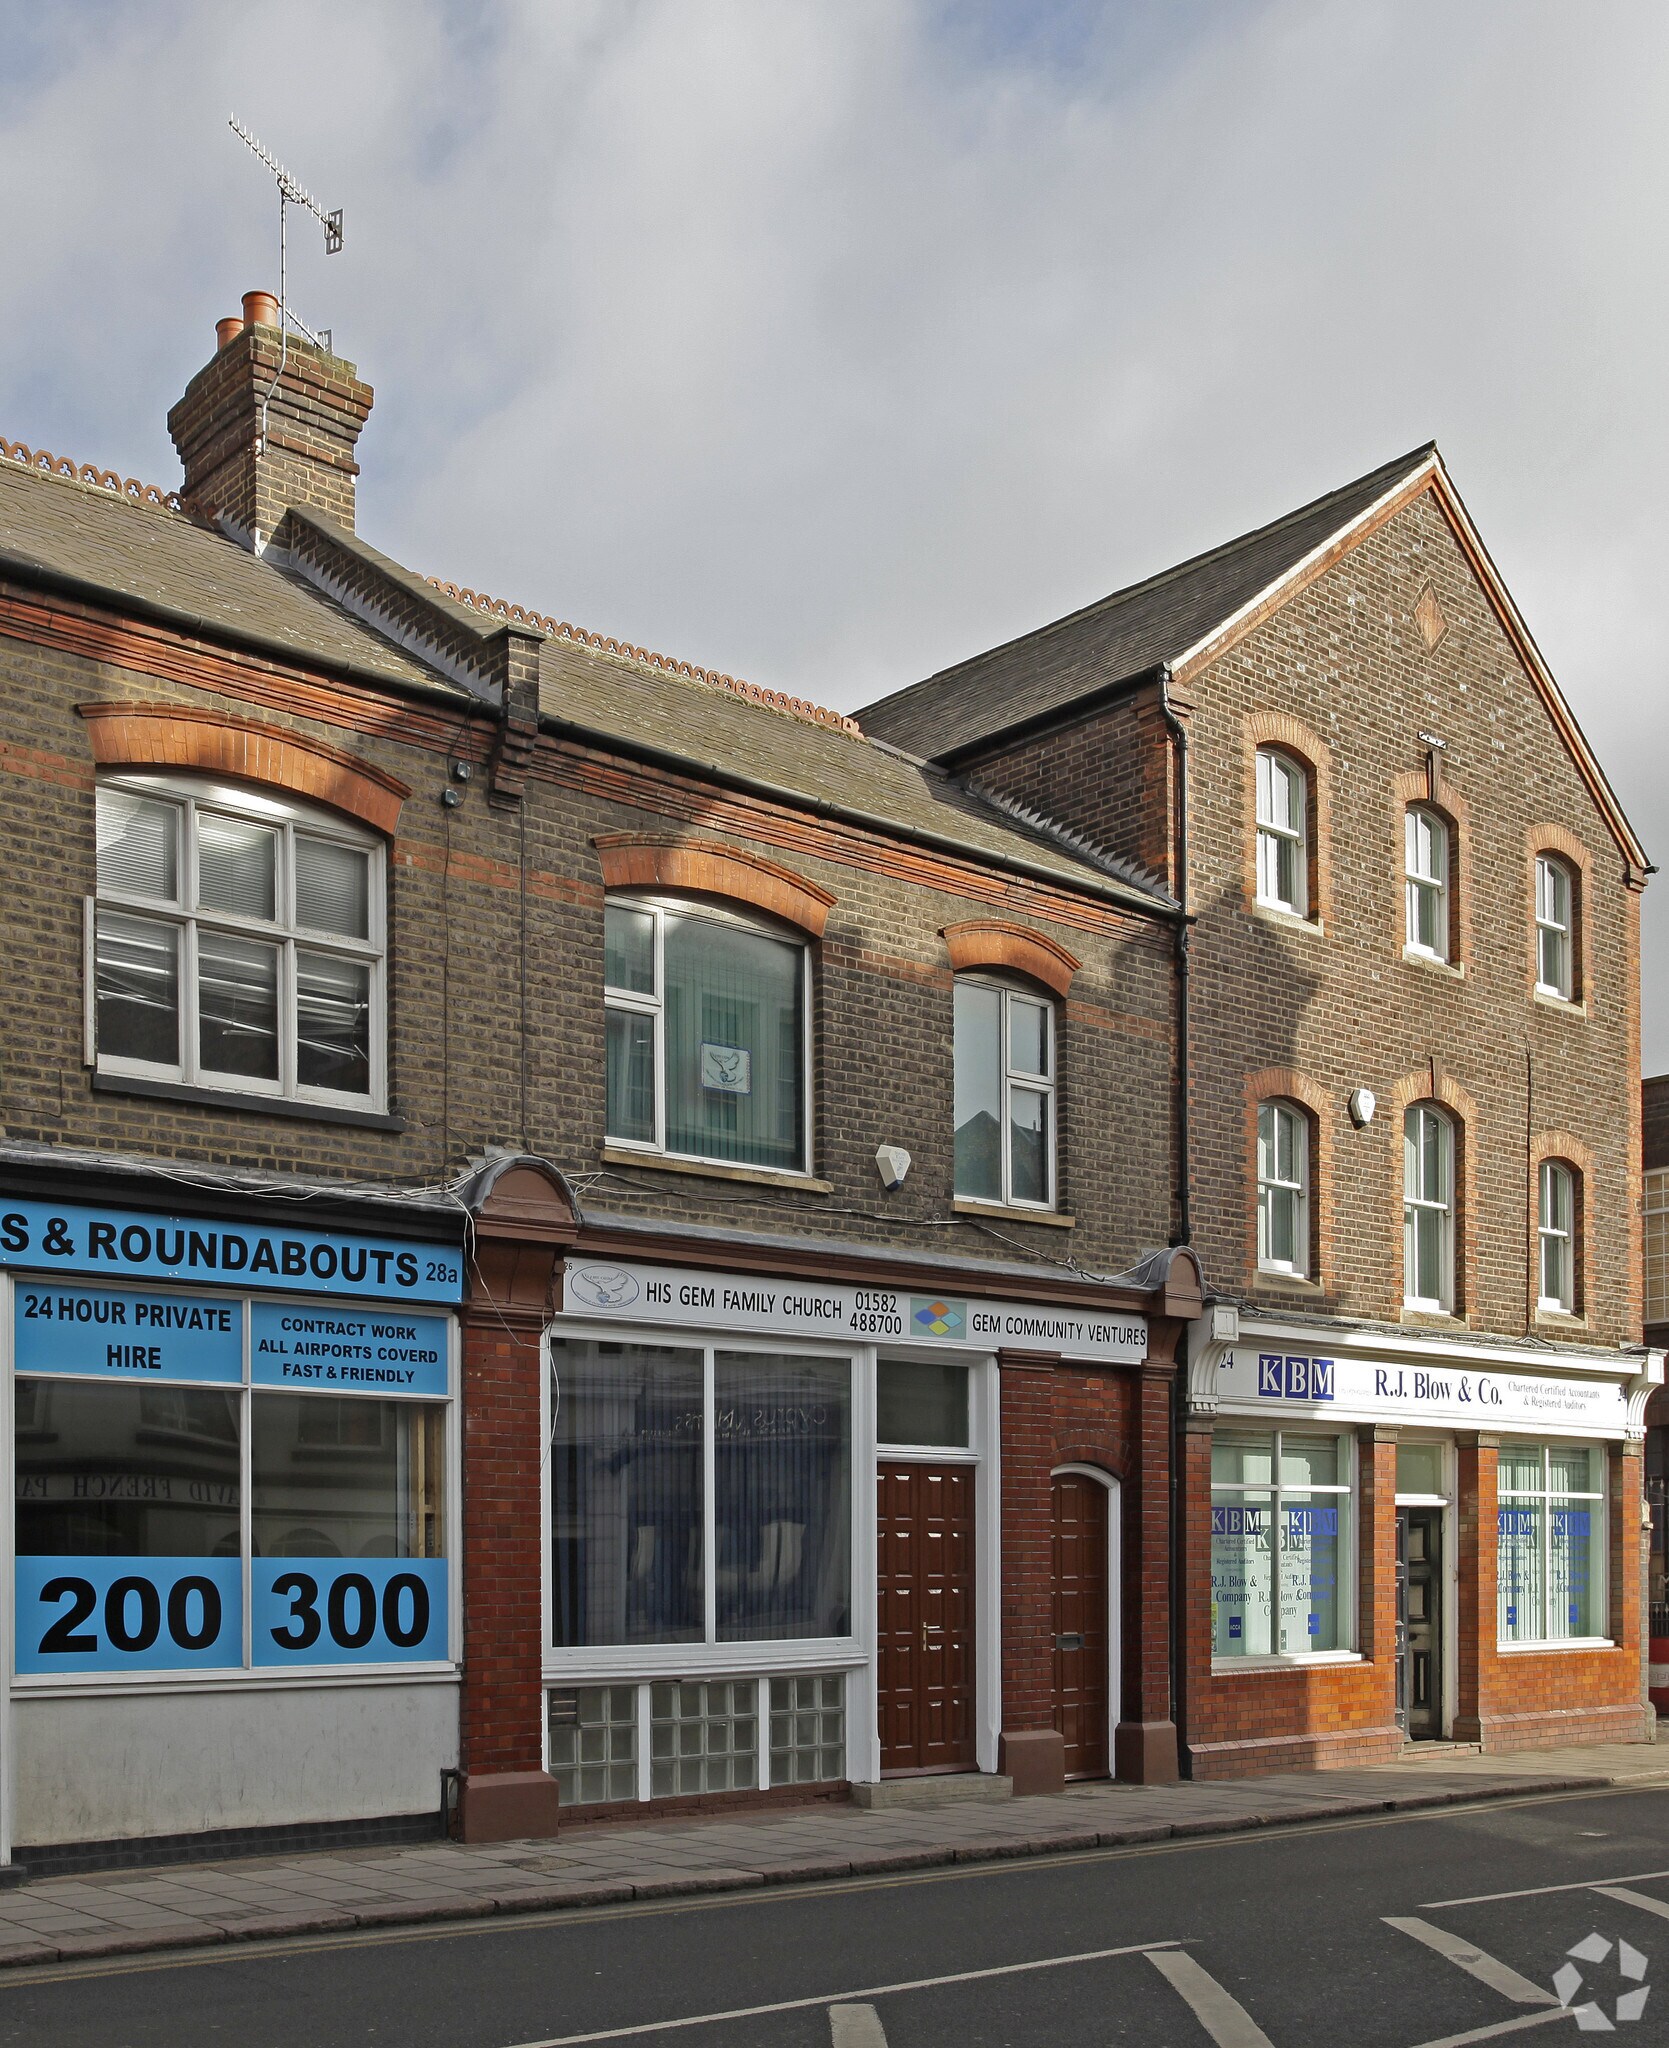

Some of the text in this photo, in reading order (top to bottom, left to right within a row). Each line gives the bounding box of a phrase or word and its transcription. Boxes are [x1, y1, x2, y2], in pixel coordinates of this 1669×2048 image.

[42, 1217, 76, 1257] &
[88, 1220, 419, 1287] ROUNDABOUTS
[425, 1261, 458, 1284] 28a
[646, 1281, 672, 1304] HIS
[679, 1285, 715, 1308] GEM
[723, 1290, 776, 1314] FAMILY
[782, 1295, 842, 1320] CHURCH
[855, 1291, 897, 1313] 01582
[24, 1294, 232, 1332] 24 HOUR PRIVATE
[849, 1312, 902, 1335] 488700
[281, 1317, 417, 1341] CONTRACT WORK
[972, 1313, 1146, 1346] GEM COMMUNITY VENTURES
[106, 1344, 162, 1370] HIRE
[258, 1338, 438, 1364] ALL AIRPORTS COVERD
[1219, 1351, 1234, 1370] 24
[282, 1362, 415, 1384] FAST & FRIENDLY
[1375, 1368, 1503, 1406] R.J. Blow & Co.
[1508, 1381, 1601, 1400] Chartered Certified Accountants
[1531, 1396, 1561, 1409] Registered
[1229, 1575, 1247, 1588] Blow
[1250, 1574, 1258, 1588] &
[1216, 1590, 1253, 1606] Company
[38, 1575, 223, 1654] 200
[269, 1572, 430, 1650] 300
